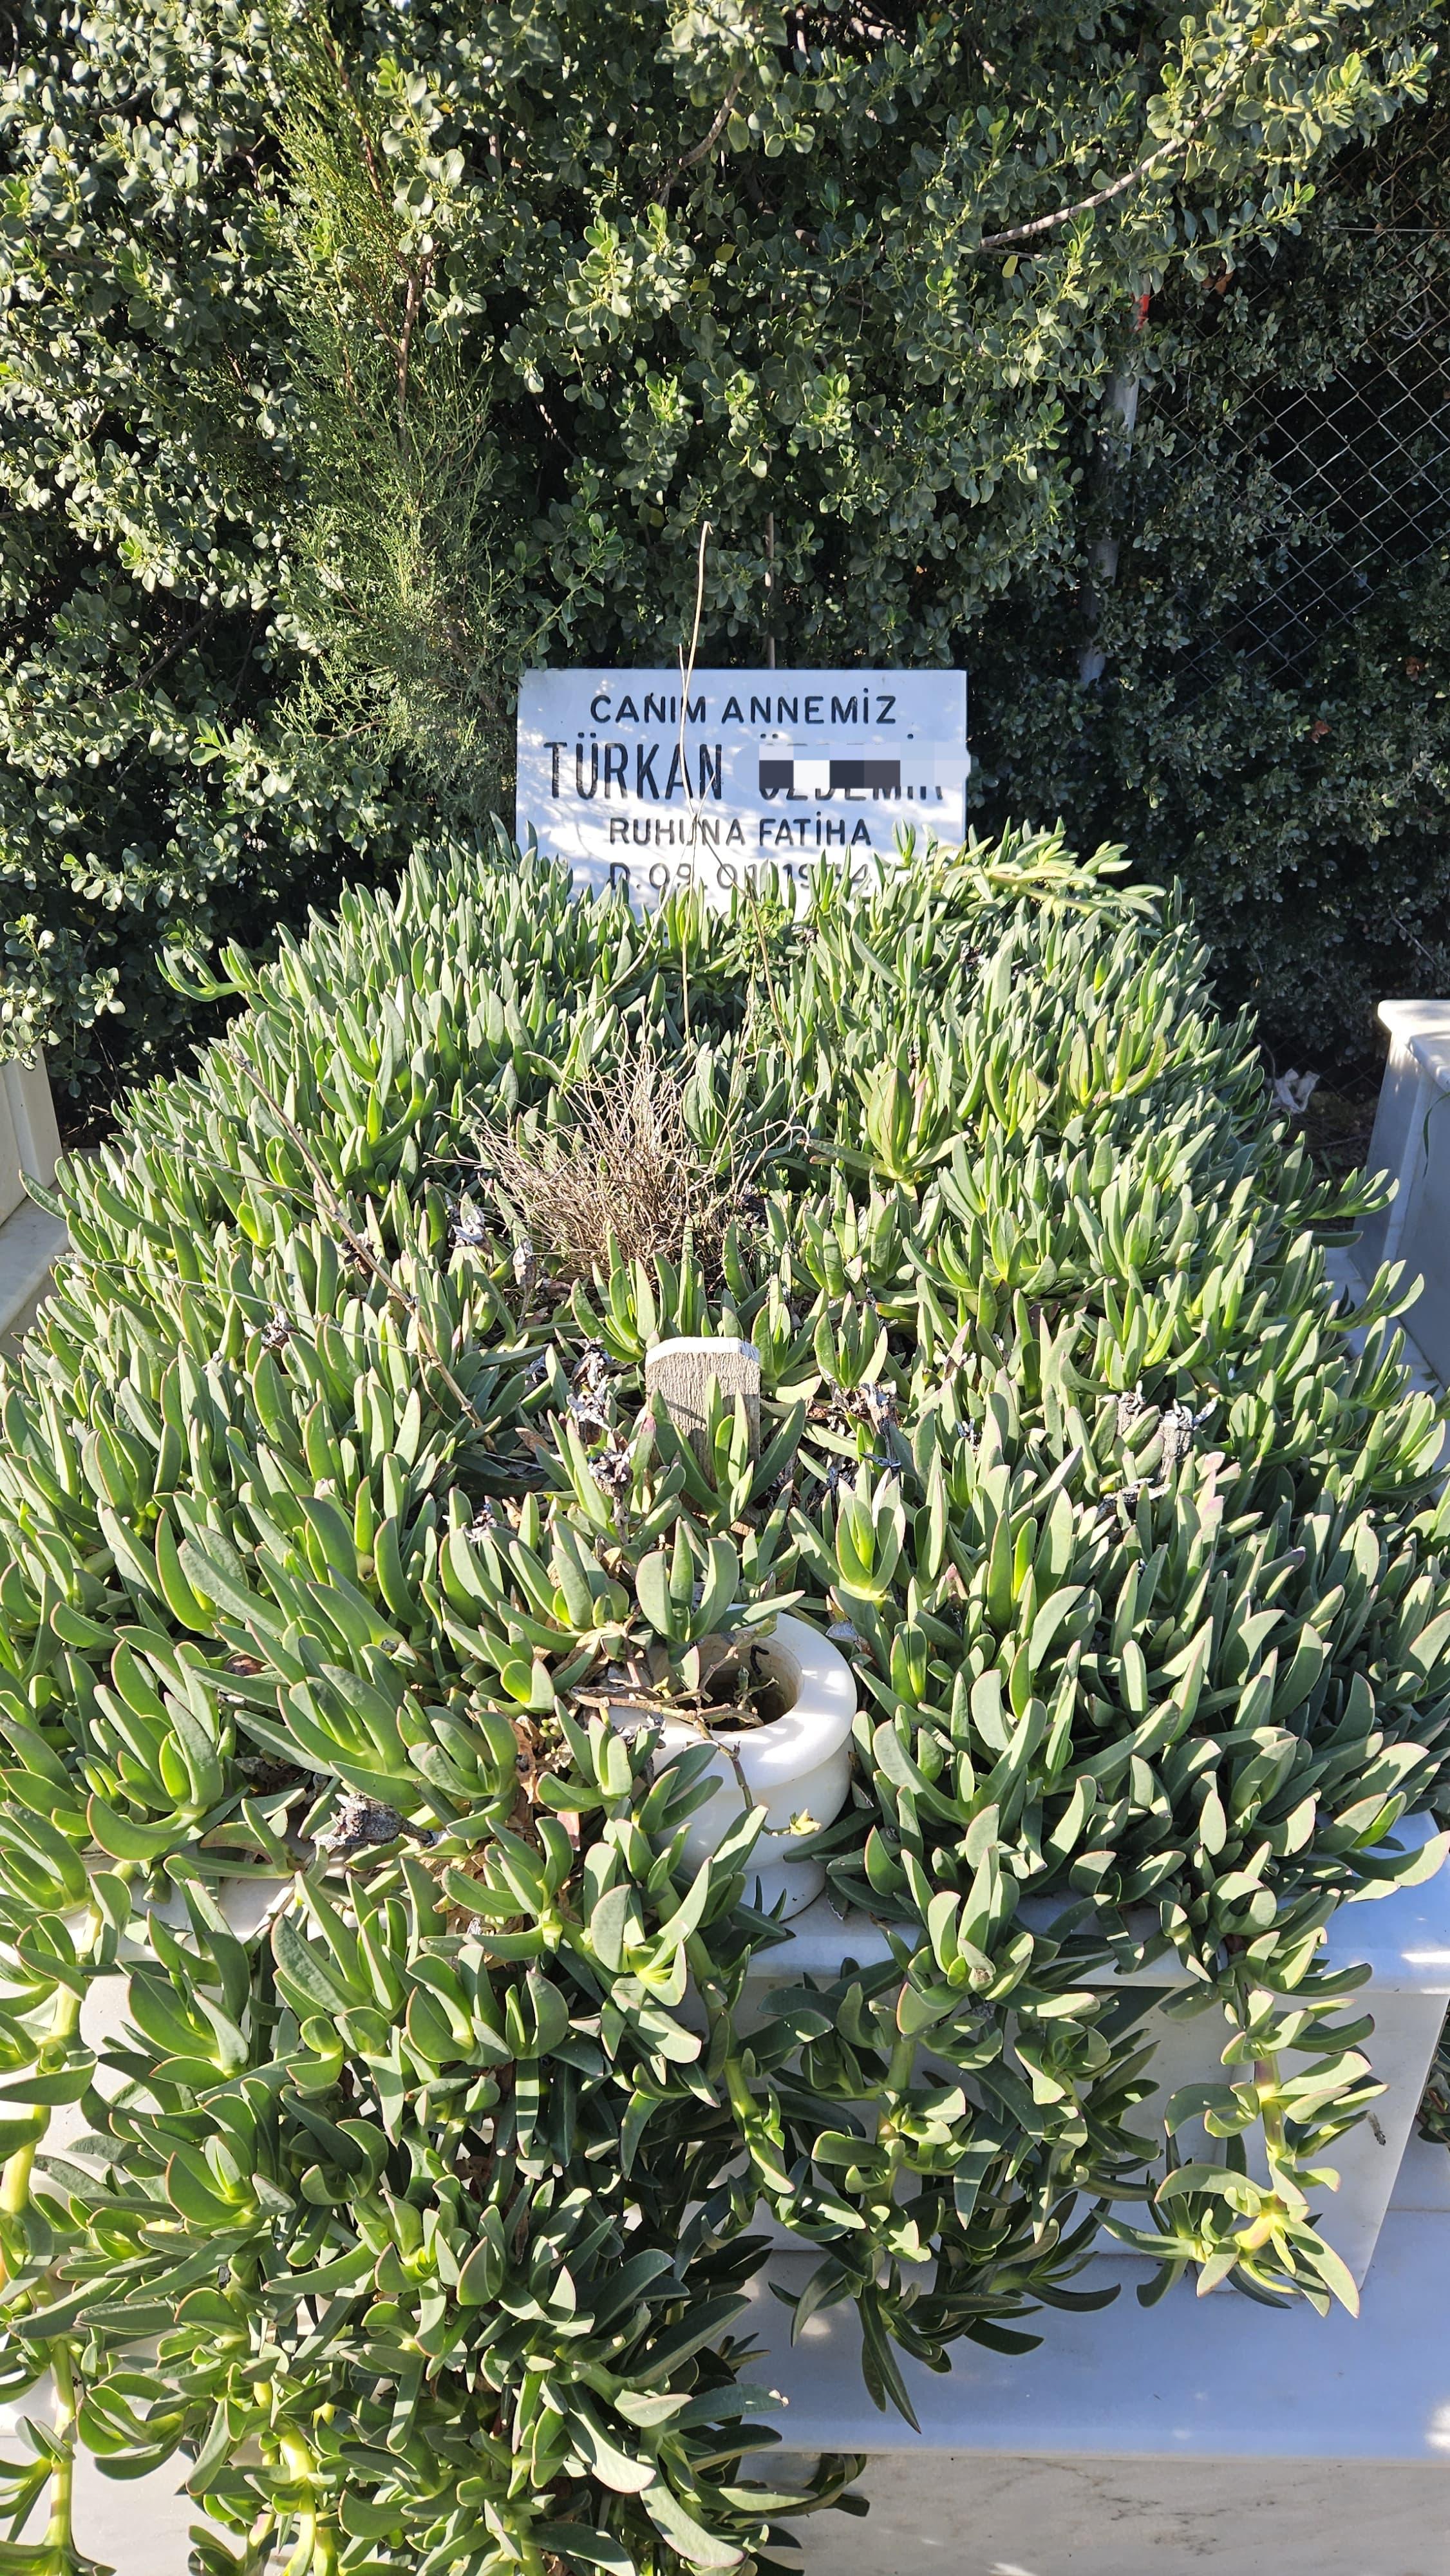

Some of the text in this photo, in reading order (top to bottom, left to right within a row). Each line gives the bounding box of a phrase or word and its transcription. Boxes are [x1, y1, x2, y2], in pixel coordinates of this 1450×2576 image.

[590, 687, 896, 724] CANIM ANNEMİZ
[543, 732, 722, 800] TÜRKAN
[609, 811, 871, 846] RUHUNA FATİHA
